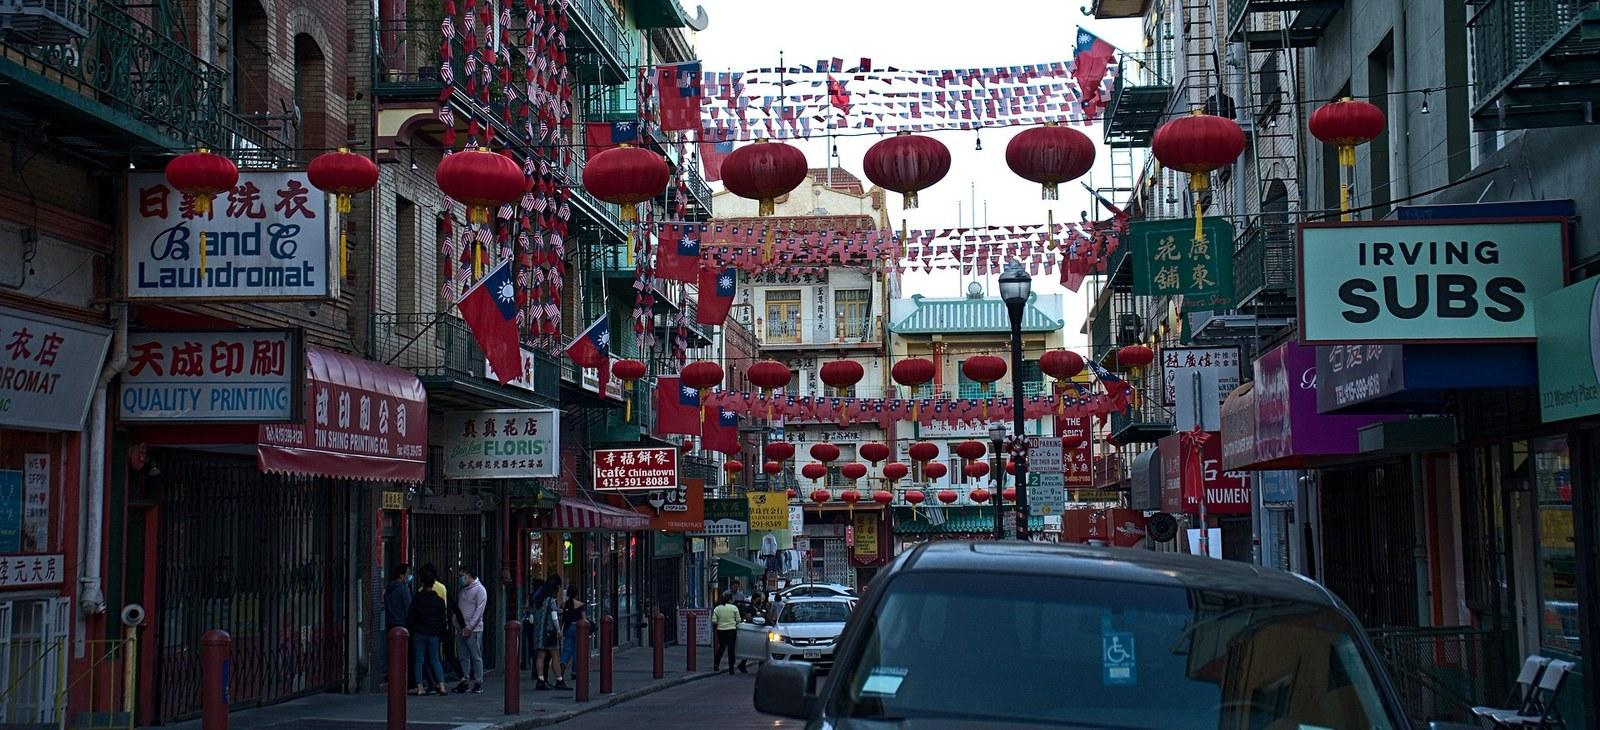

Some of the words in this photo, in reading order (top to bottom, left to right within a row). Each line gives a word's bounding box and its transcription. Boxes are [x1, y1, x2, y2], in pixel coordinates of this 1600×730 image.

[151, 221, 191, 261] B
[200, 223, 261, 256] and
[1359, 241, 1499, 265] IRVING
[138, 261, 314, 288] Laundromat
[1338, 274, 1526, 323] SUBS
[128, 340, 286, 377] 天成印刷
[123, 387, 202, 413] QUALITY
[210, 386, 288, 411] PRINTING
[1554, 384, 1578, 408] Waverly
[1579, 381, 1598, 401] Place
[463, 418, 538, 438] 真真花店
[1066, 417, 1081, 426] THE
[314, 428, 327, 447] TIN
[328, 431, 349, 450] SHING
[350, 435, 379, 454] PRINTING
[484, 440, 551, 456] FLORIS
[1029, 438, 1039, 448] NO
[1040, 439, 1062, 448] PARKING
[603, 451, 670, 466] 幸福餅家
[602, 477, 670, 487] 415-391-8088
[628, 468, 675, 478] Chinatown
[1031, 476, 1039, 486] 2
[1188, 488, 1251, 504] MNUMEN
